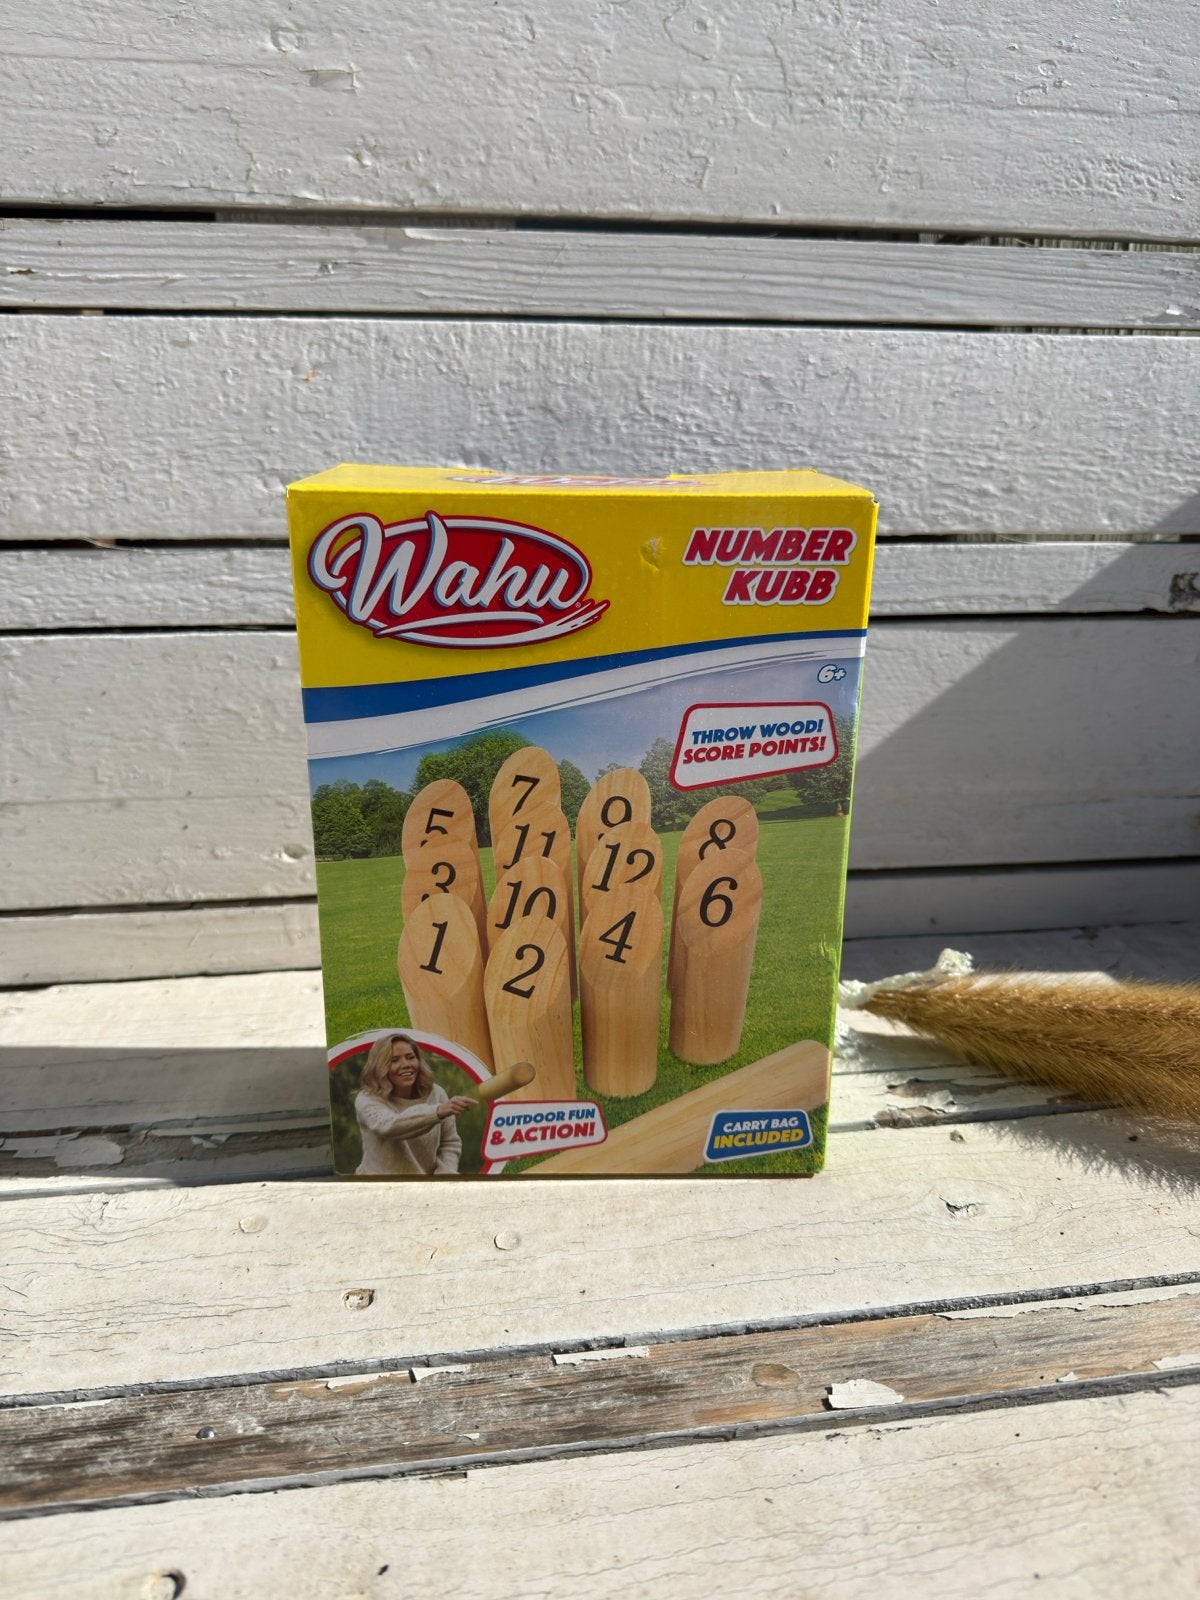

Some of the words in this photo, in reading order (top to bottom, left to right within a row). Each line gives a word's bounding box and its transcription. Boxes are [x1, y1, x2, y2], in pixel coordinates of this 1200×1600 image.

[310, 510, 588, 618] Wahu
[684, 526, 857, 567] NUMBER
[722, 568, 841, 606] KUBB
[817, 664, 846, 683] 6+
[683, 743, 745, 764] SCORE
[748, 736, 826, 758] POINTS!
[692, 725, 756, 744] THROW
[760, 719, 824, 738] WOOD!
[511, 774, 540, 816] 7
[420, 807, 454, 848] 5
[699, 876, 738, 928] 6
[419, 921, 449, 975] 1
[599, 910, 637, 964] 4
[501, 943, 545, 999] 2
[490, 1131, 506, 1146] &
[510, 1121, 596, 1145] ACTION!
[493, 1109, 566, 1128] OUTDOOR
[568, 1107, 596, 1121] FUN
[722, 1118, 768, 1132] CARRY
[770, 1116, 799, 1129] BAG
[713, 1129, 804, 1149] INCLUDED
